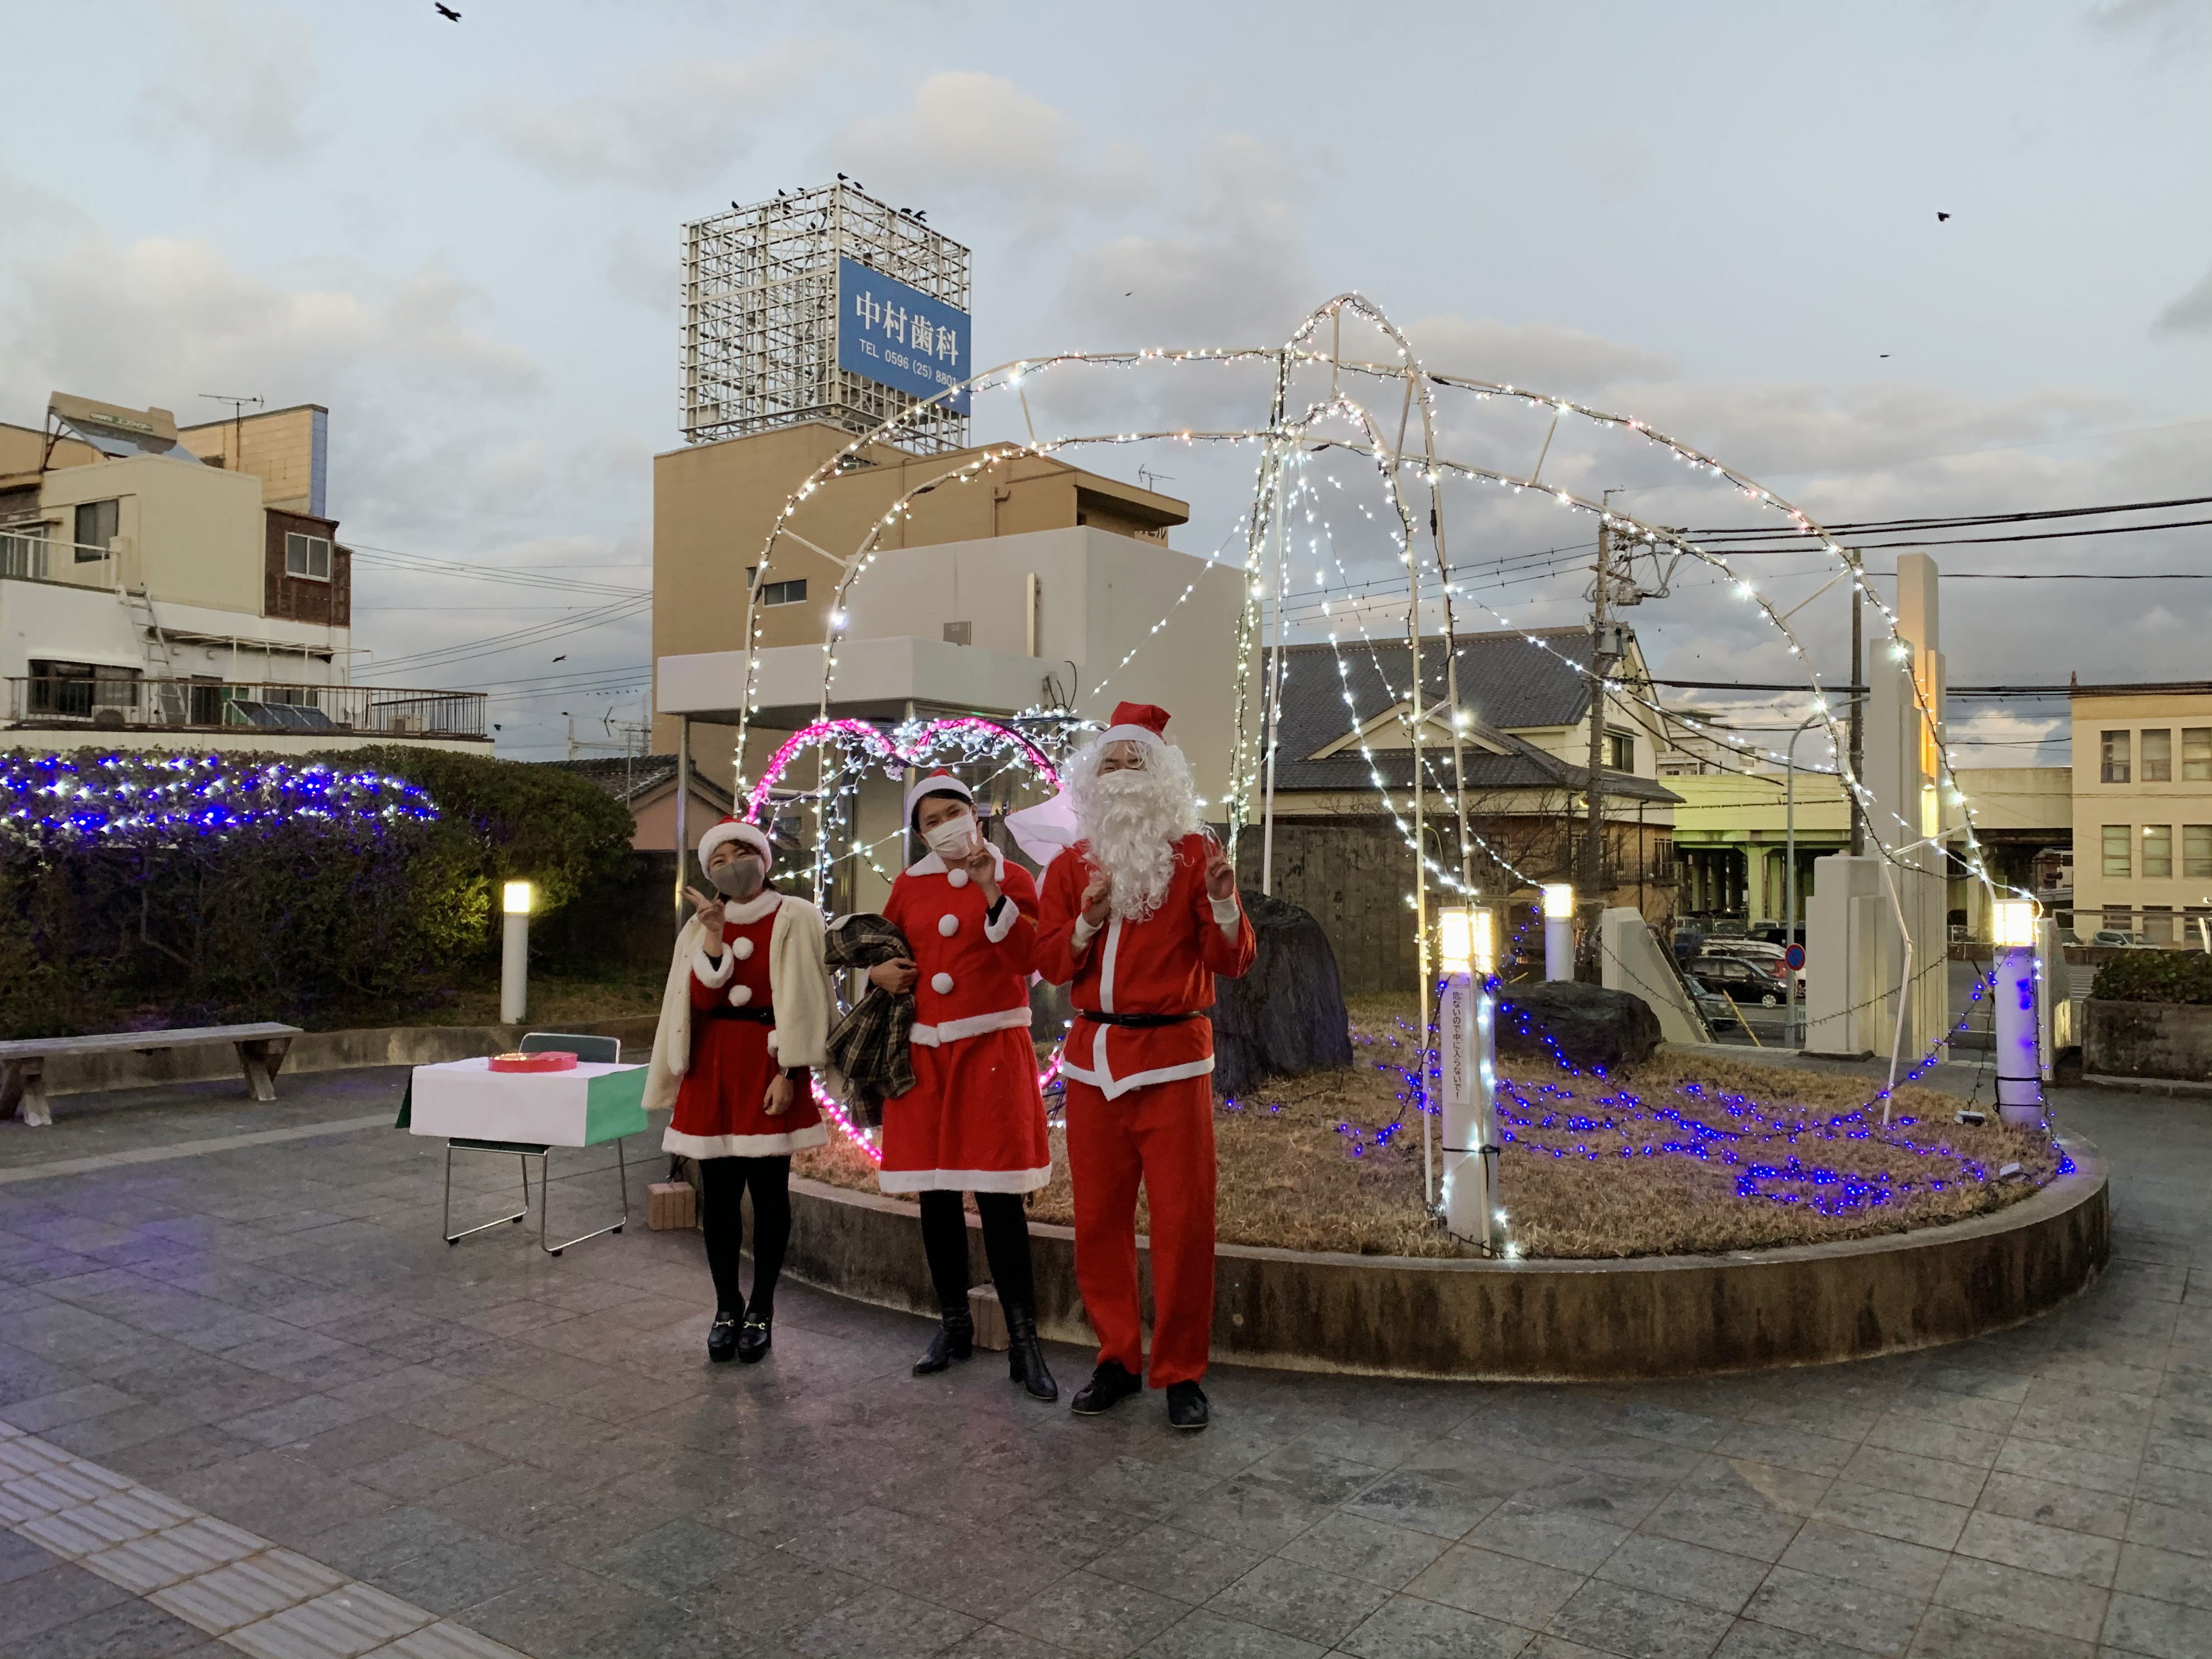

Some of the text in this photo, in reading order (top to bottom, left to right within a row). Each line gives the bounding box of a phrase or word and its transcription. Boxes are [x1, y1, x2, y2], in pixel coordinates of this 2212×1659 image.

[856, 291, 959, 366] 中村歯科
[859, 338, 879, 358] TEL
[885, 349, 909, 369] 0596
[912, 359, 932, 380] (25)
